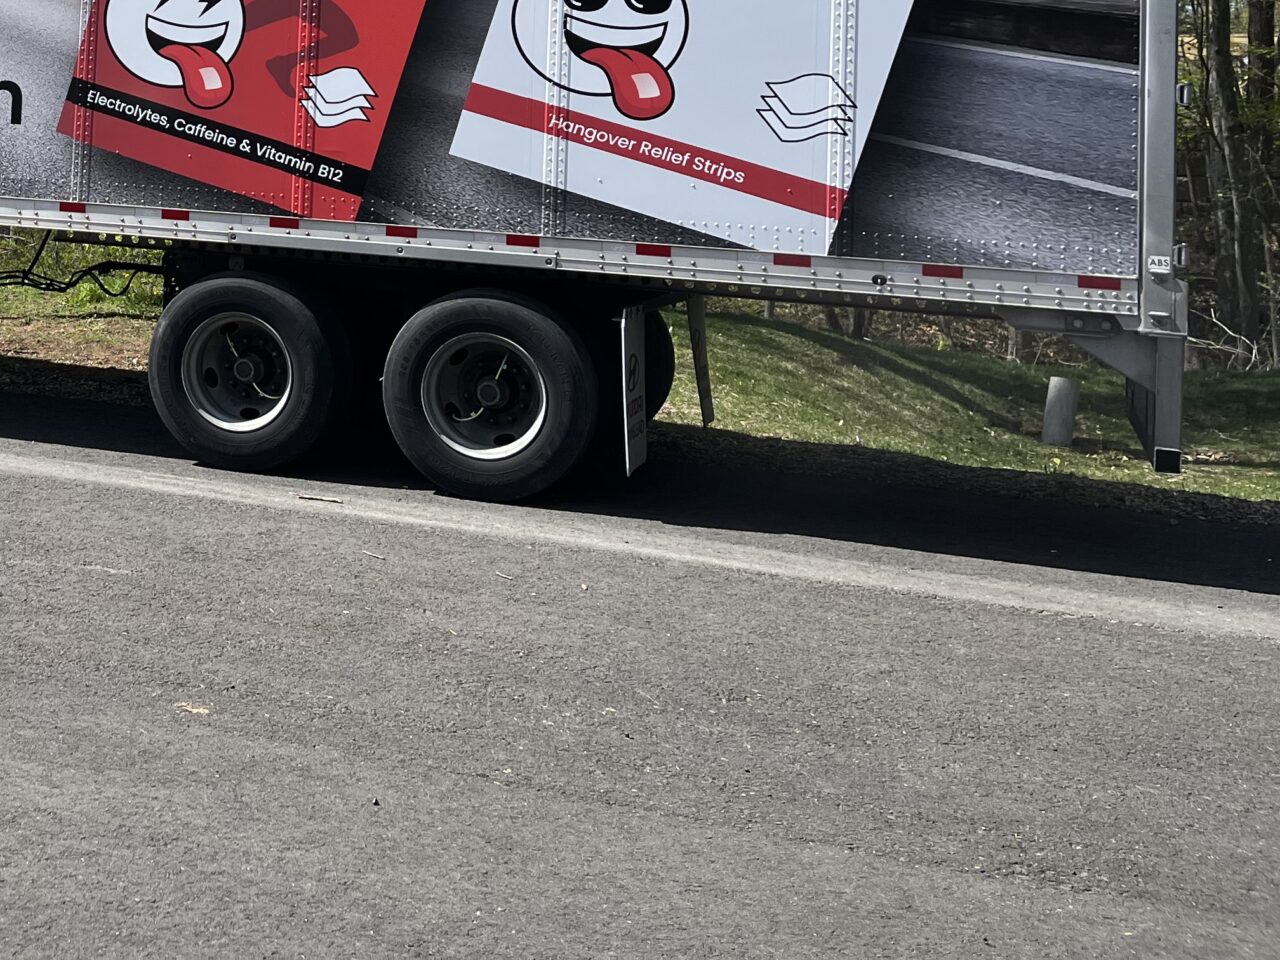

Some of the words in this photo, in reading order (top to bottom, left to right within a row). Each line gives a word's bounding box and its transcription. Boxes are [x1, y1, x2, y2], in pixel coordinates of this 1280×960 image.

[87, 89, 171, 129] Electrolytes,
[174, 117, 236, 149] Caffeine
[239, 138, 252, 154] &
[256, 142, 314, 174] Vitamin
[317, 164, 344, 183] B12
[549, 114, 637, 152] Hangover
[639, 134, 690, 167] Relief
[692, 156, 745, 184] Strips
[1149, 258, 1170, 268] ABS
